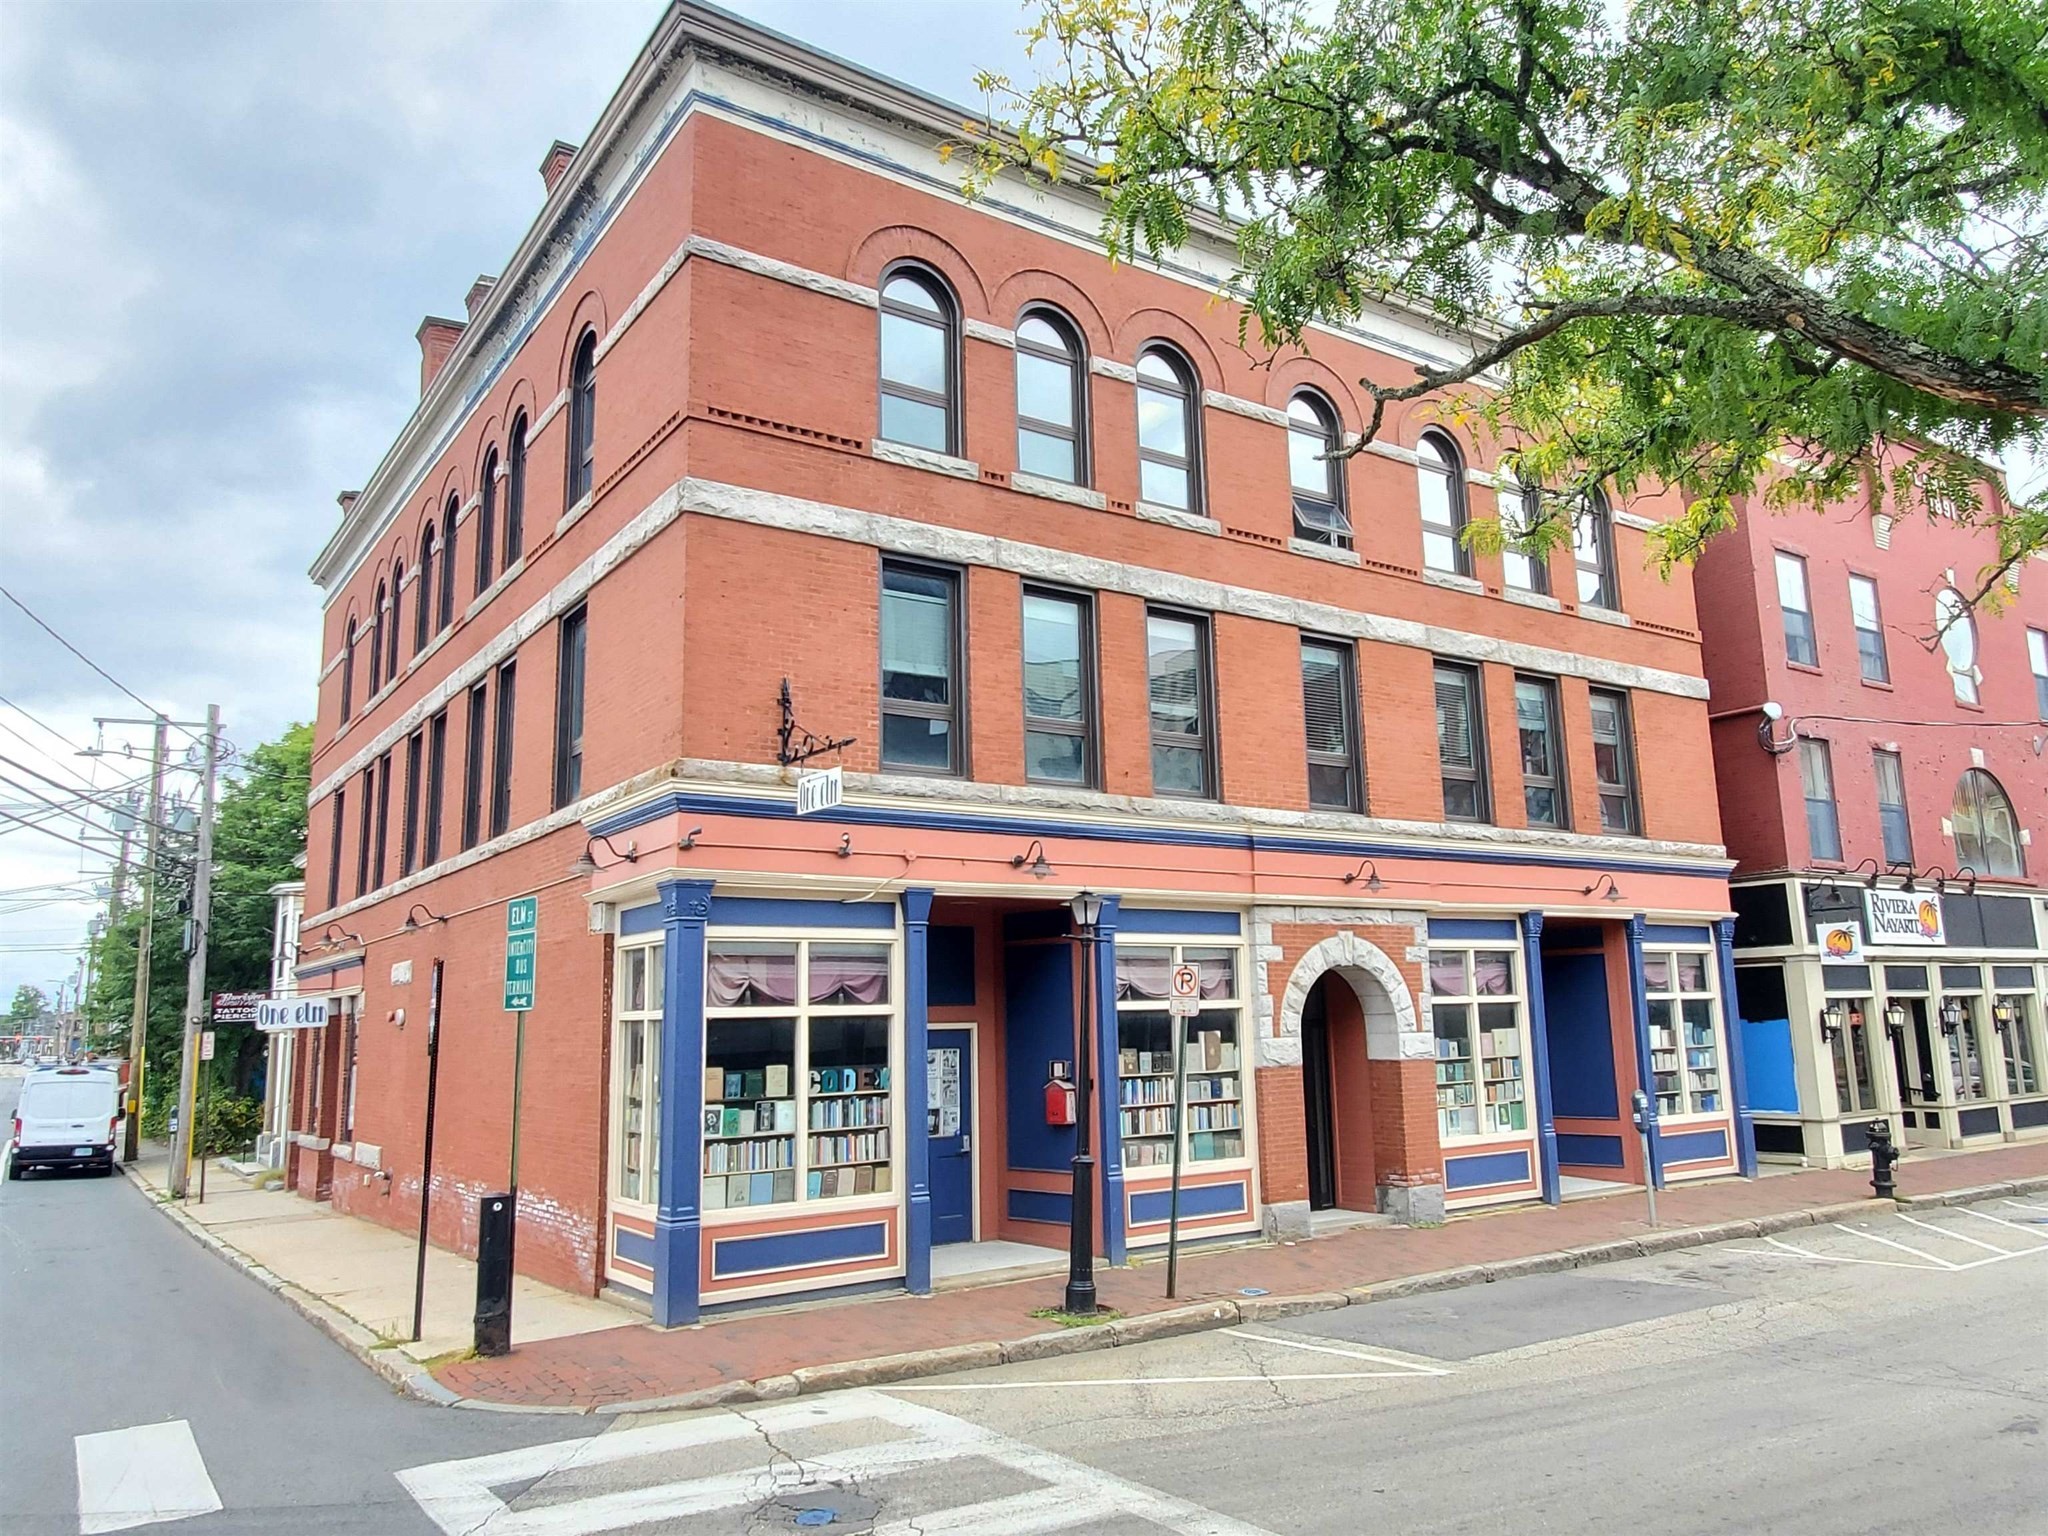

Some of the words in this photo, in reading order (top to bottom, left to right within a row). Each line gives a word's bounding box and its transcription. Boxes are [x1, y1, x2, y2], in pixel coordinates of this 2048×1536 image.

[1870, 893, 1917, 915] RIVIERA
[511, 906, 527, 926] ELM
[1873, 913, 1920, 934] NAYARIT
[260, 1004, 289, 1026] One
[295, 1002, 328, 1024] elm
